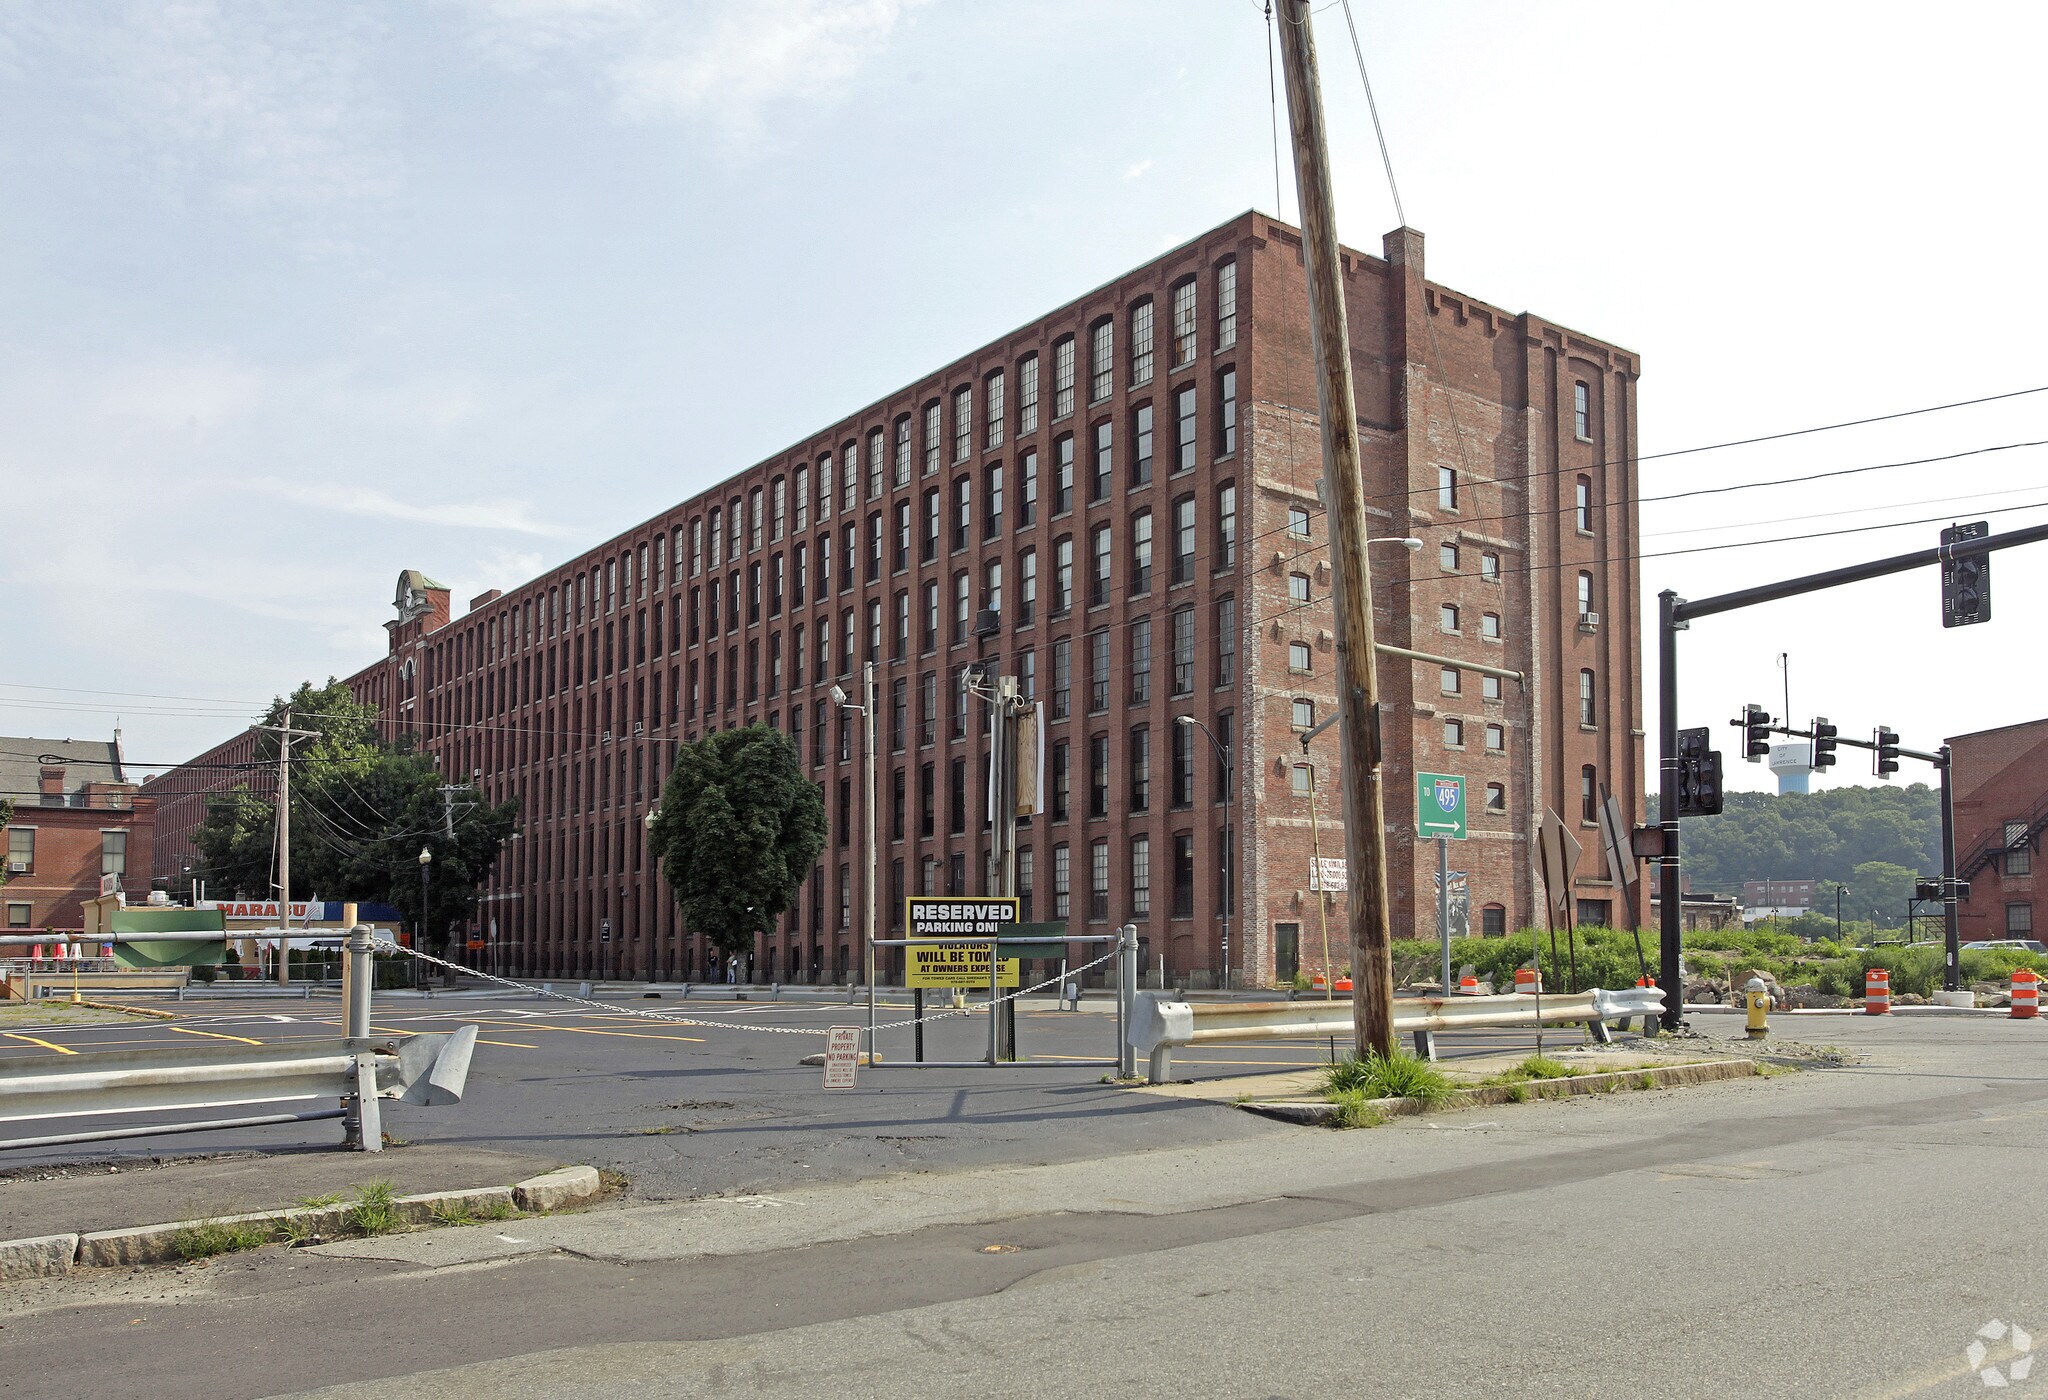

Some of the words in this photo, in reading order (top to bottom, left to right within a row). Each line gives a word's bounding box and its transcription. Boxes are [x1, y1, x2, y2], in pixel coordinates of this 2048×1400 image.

[1423, 787, 1431, 797] TO
[1439, 788, 1455, 806] 495
[912, 904, 1014, 920] RESERVED
[916, 922, 974, 933] PARKING
[917, 951, 947, 963] WILL
[950, 951, 965, 963] BE
[920, 964, 931, 973] AT
[933, 964, 969, 973] OWNERS
[970, 964, 1006, 973] EXPESE
[835, 1032, 854, 1041] PRIVATE
[831, 1042, 856, 1051] PROPERTY
[828, 1053, 836, 1061] NO
[836, 1053, 857, 1061] PARKING
